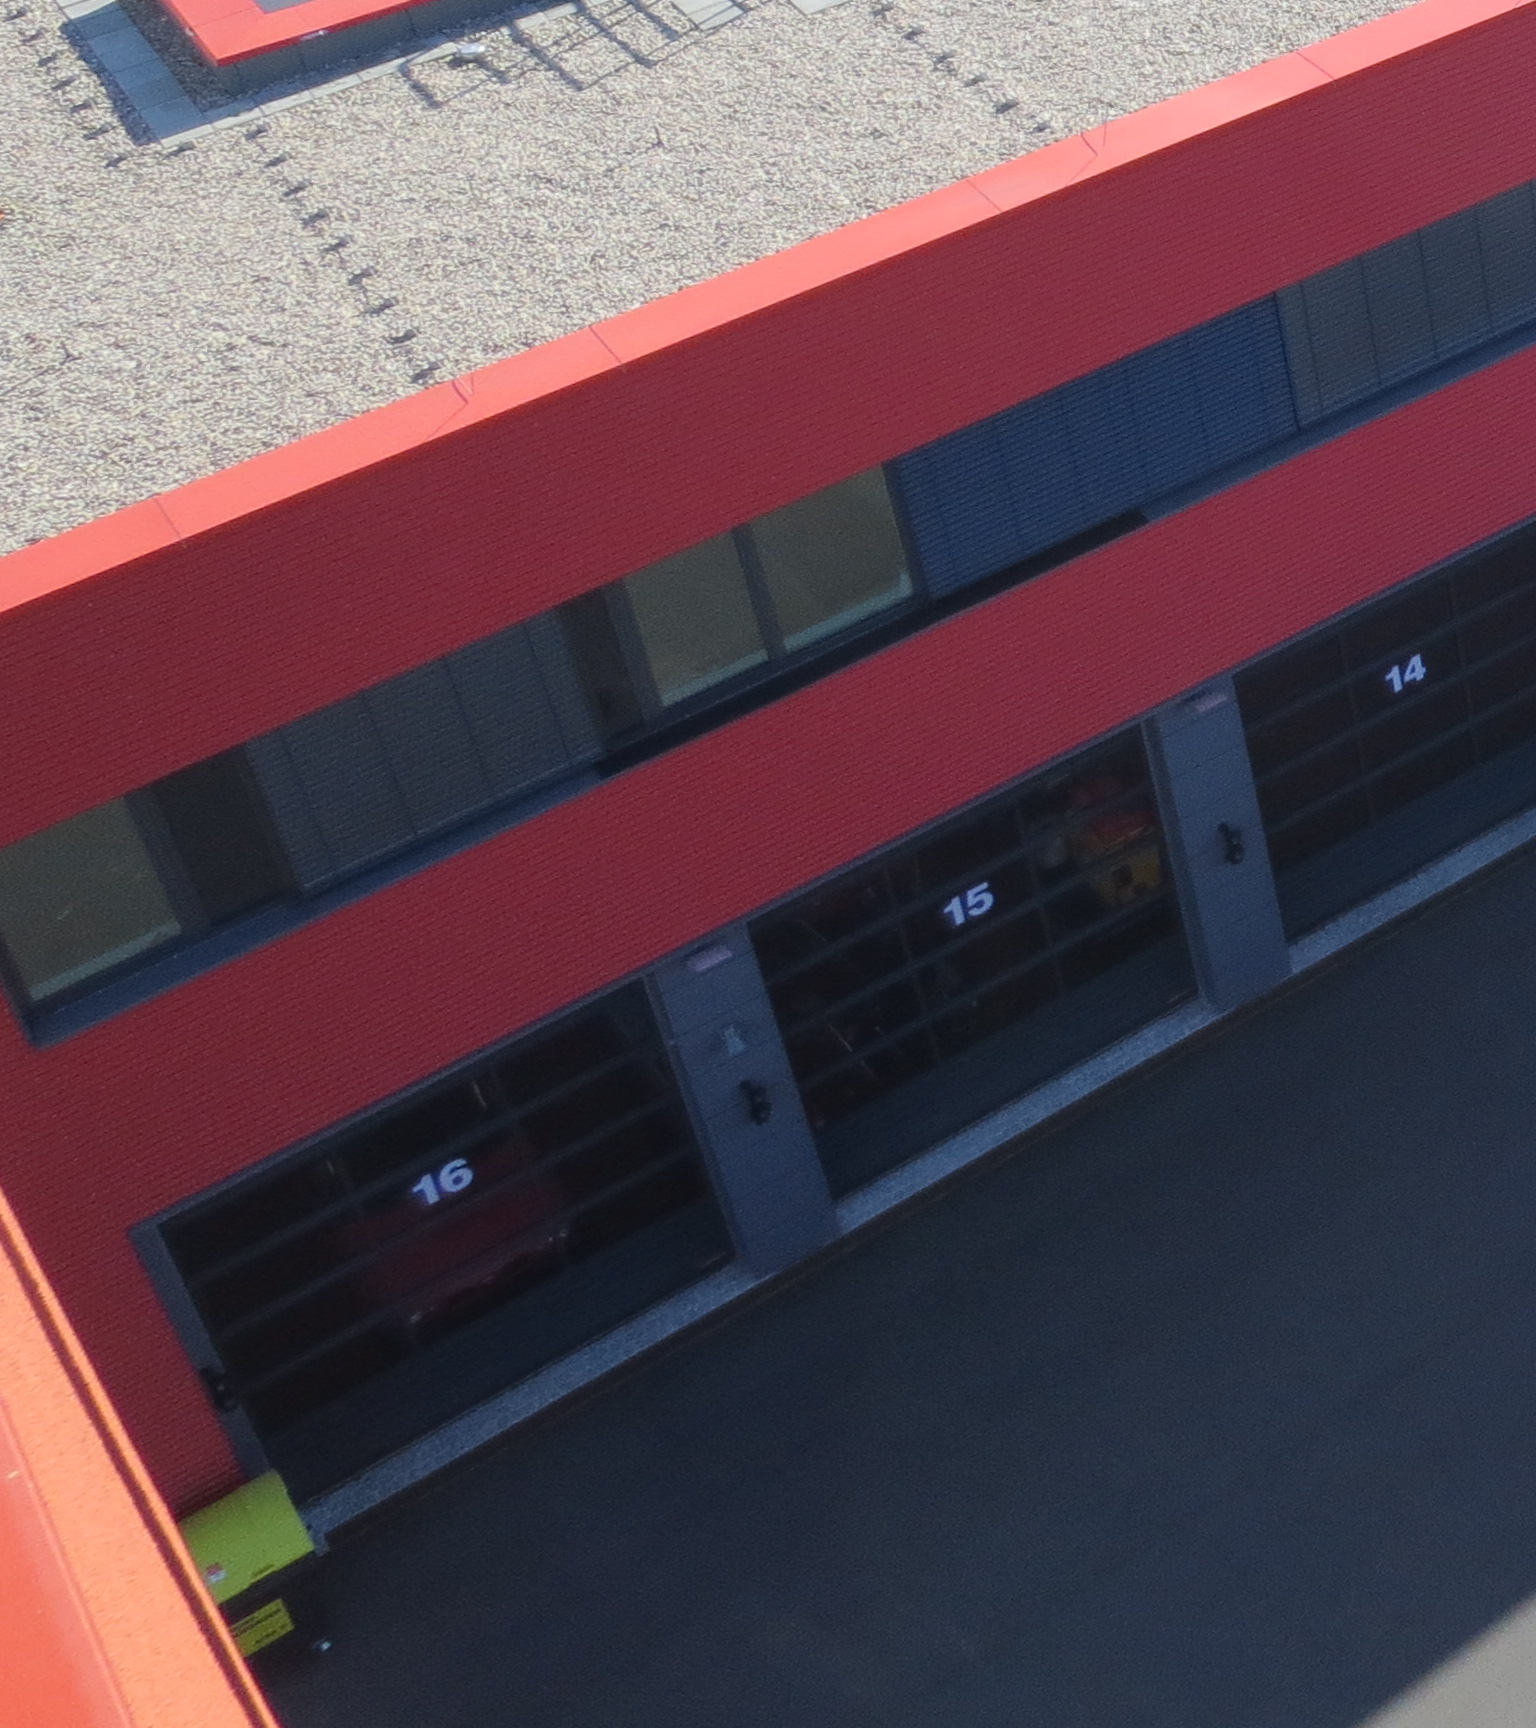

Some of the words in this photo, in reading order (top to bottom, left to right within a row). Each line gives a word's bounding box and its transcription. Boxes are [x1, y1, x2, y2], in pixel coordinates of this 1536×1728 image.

[1386, 654, 1426, 692] 14
[943, 882, 992, 925] 15
[412, 1159, 472, 1205] 16
